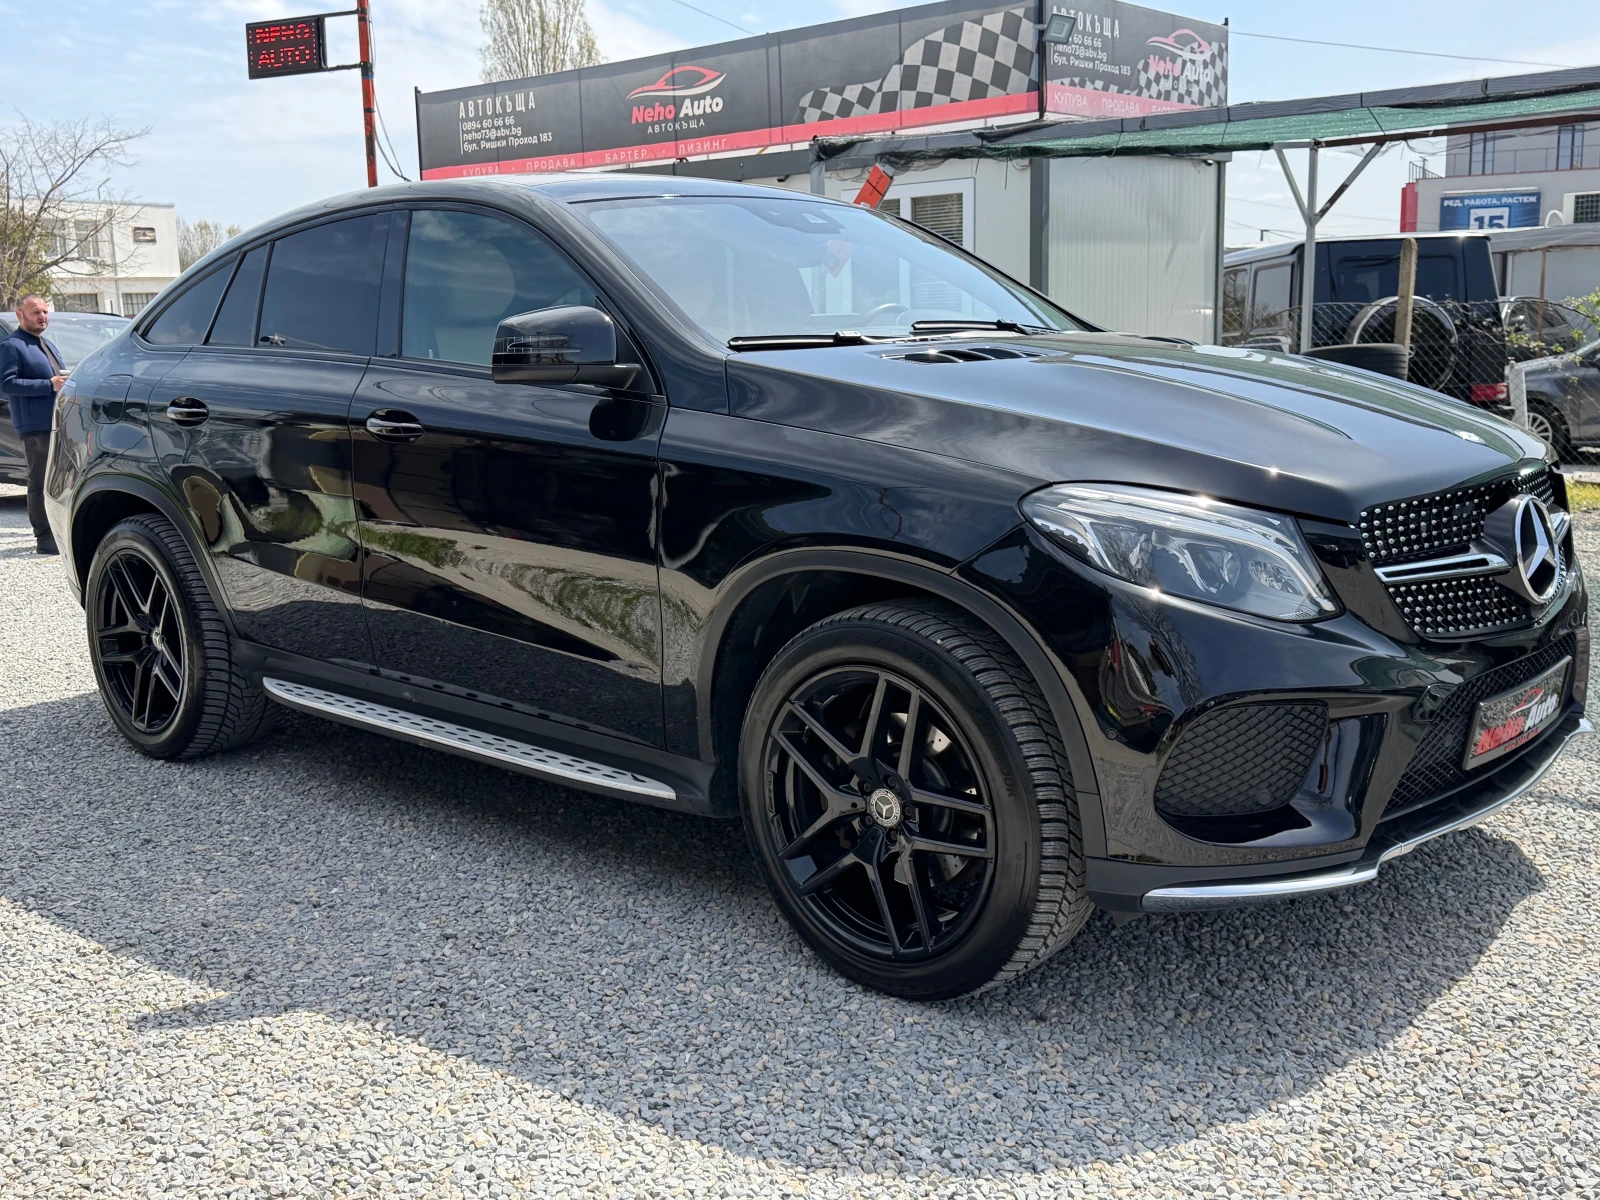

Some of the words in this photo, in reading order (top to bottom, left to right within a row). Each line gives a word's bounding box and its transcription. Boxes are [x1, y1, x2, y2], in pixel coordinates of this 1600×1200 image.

[1073, 33, 1083, 44] 60
[1083, 35, 1092, 46] 66
[1093, 37, 1102, 48] 66
[258, 46, 310, 68] AUTO
[1053, 52, 1068, 66] бул.
[1070, 56, 1093, 70] Ришки
[1094, 60, 1119, 75] Проход
[1120, 65, 1131, 76] 183
[1148, 54, 1181, 77] Neho
[1184, 61, 1211, 83] Auto
[459, 91, 536, 119] АВТОКЪЩА
[631, 102, 676, 125] Neho
[679, 95, 724, 118] Auto
[1054, 91, 1088, 107] КУПУВА
[1101, 98, 1140, 114] ПРОДАВА
[462, 121, 481, 131] 0894
[482, 119, 492, 128] 60
[494, 117, 503, 127] 66
[505, 115, 515, 125] 66
[463, 126, 522, 141] neho73@abv.bg
[647, 118, 705, 134] АВТОКЪЩА
[463, 141, 479, 153] бул.
[480, 139, 507, 150] Ришки
[508, 135, 538, 148] Проход
[539, 132, 553, 143] 183
[526, 157, 577, 171] ПРОДАВА
[605, 148, 647, 163] БАРТЕР
[679, 138, 727, 155] ЛИЗИНГ
[1464, 197, 1500, 206] РАБОТА,
[1502, 196, 1538, 204] РАСТЕЖ
